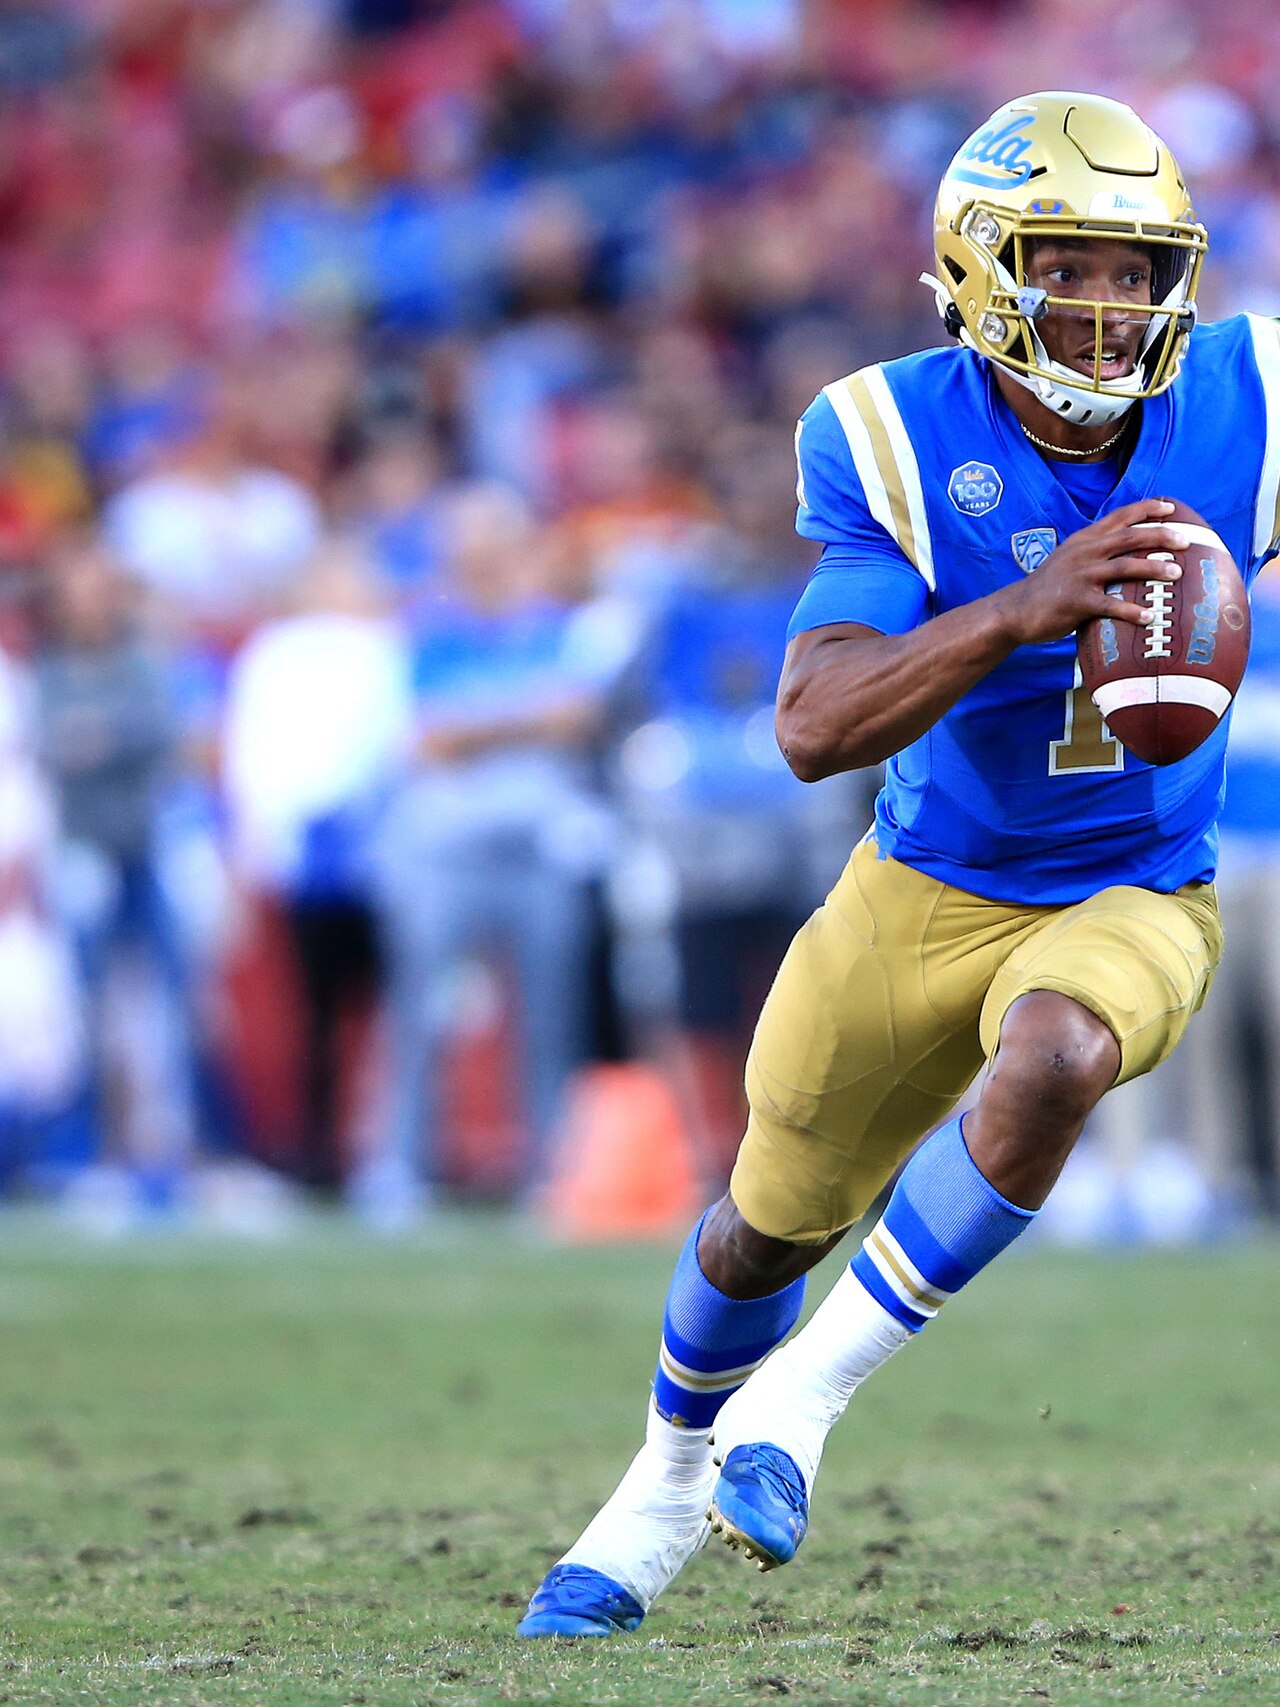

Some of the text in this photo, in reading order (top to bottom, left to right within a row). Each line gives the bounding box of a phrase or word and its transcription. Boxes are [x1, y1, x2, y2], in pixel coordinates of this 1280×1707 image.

[956, 115, 1034, 190] cla
[1112, 194, 1149, 210] Bruin
[955, 482, 997, 502] 100
[965, 501, 990, 509] YEARS
[1185, 559, 1220, 665] Wilson
[1048, 657, 1125, 776] 1
